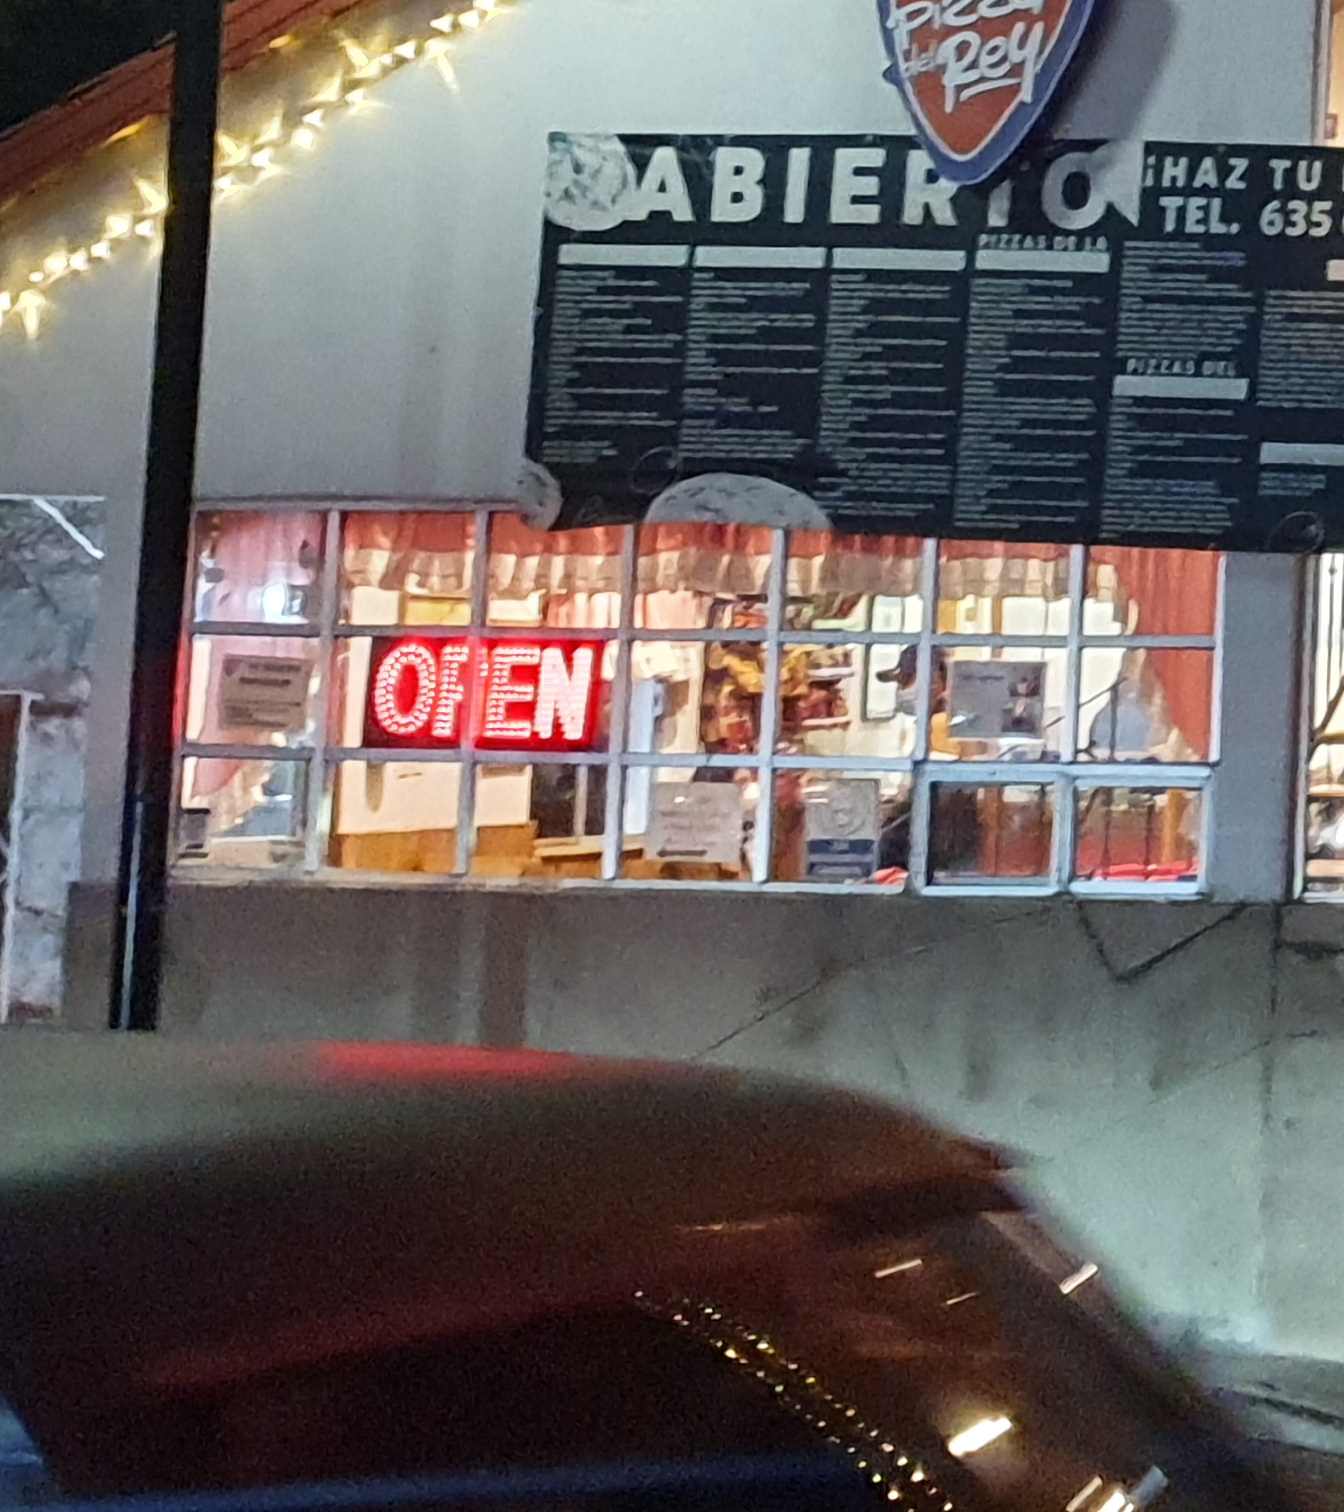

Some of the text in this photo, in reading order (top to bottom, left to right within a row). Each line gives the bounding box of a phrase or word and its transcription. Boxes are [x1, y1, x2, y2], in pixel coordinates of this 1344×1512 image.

[936, 21, 1045, 114] Rey
[1268, 158, 1323, 191] TU
[1159, 196, 1240, 235] TEL.
[1259, 199, 1333, 238] 635
[373, 643, 594, 742] OPEN
